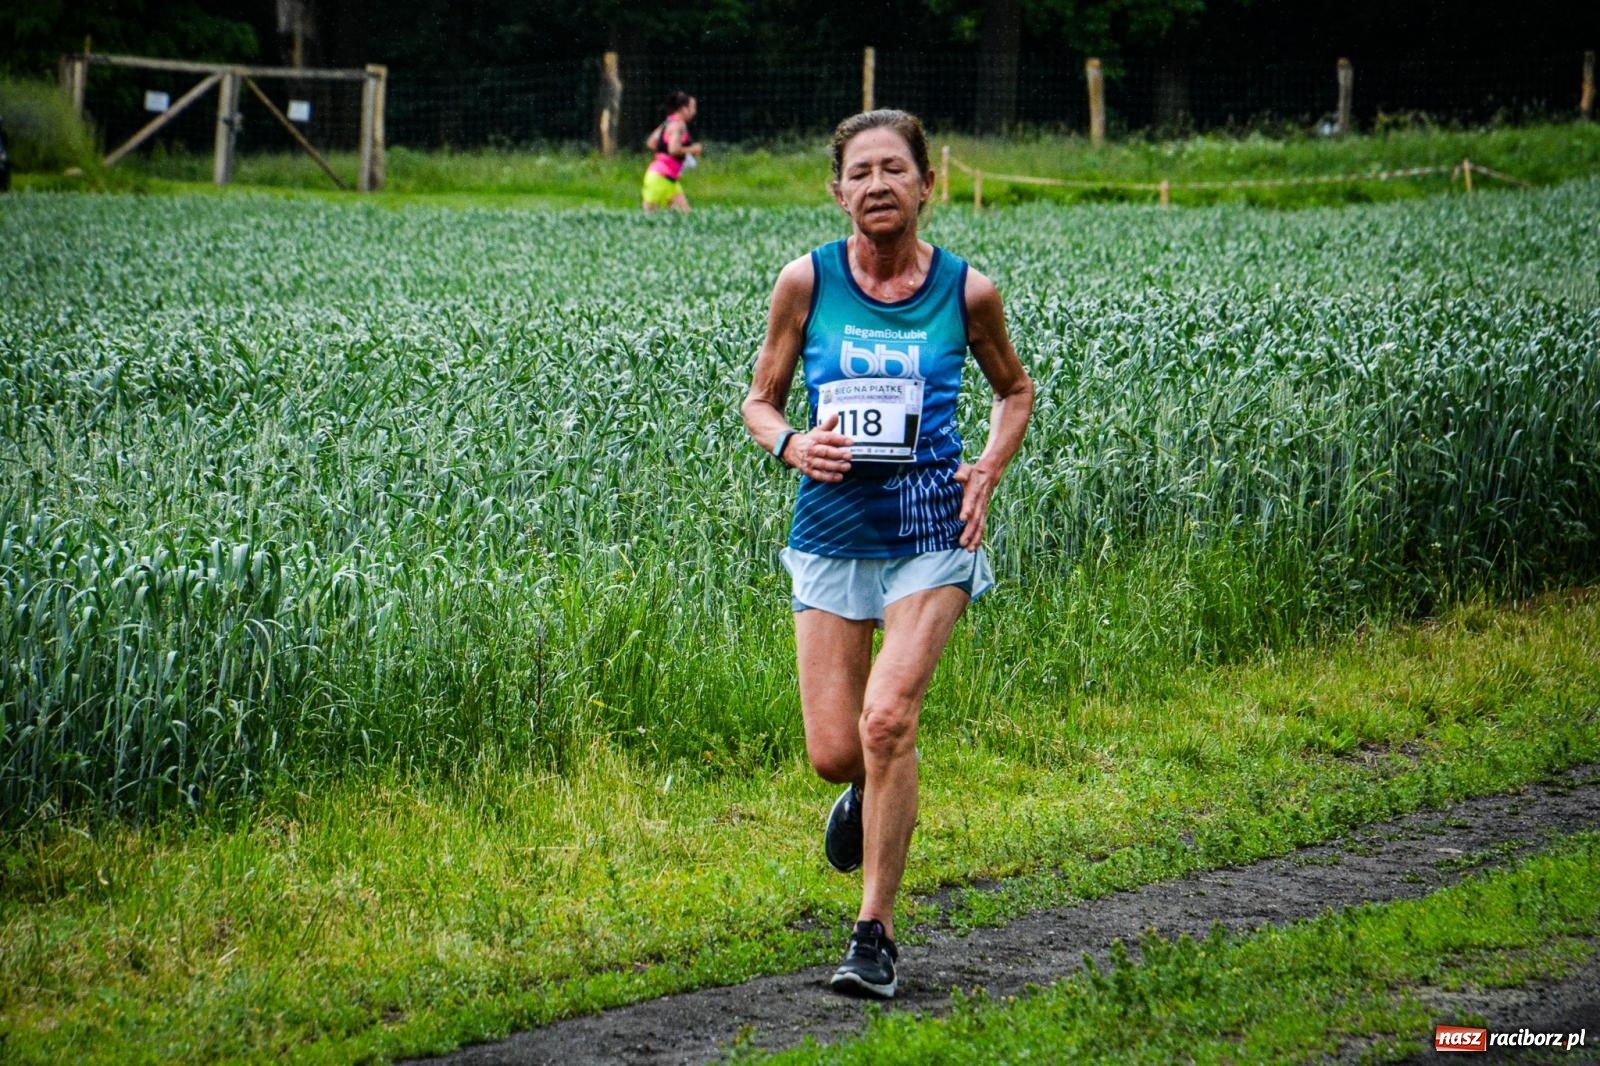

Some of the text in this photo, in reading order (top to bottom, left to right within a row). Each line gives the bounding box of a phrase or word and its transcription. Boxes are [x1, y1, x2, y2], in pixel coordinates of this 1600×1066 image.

[840, 340, 926, 380] bbl
[835, 386, 852, 395] BIEG
[838, 409, 882, 437] 118
